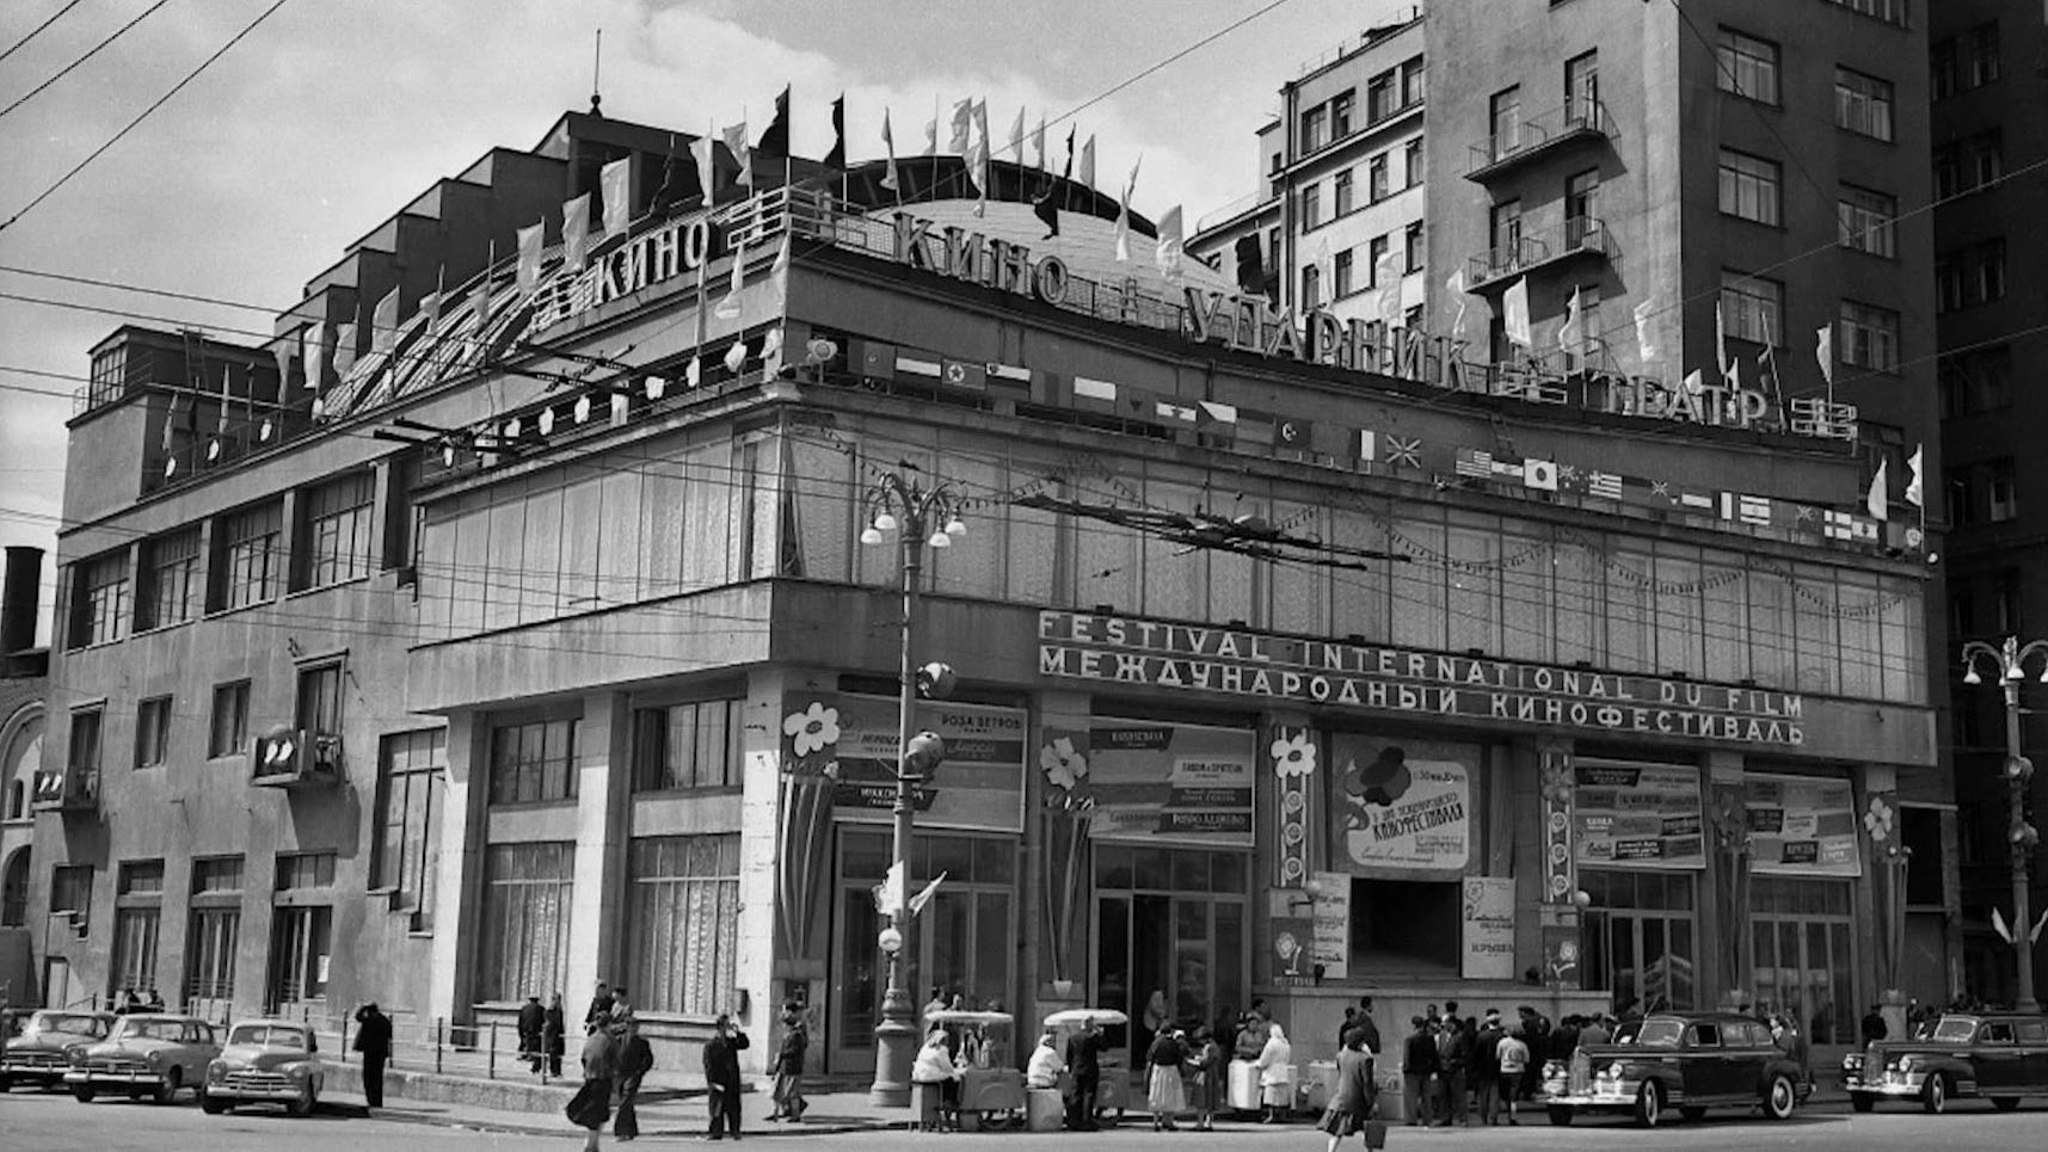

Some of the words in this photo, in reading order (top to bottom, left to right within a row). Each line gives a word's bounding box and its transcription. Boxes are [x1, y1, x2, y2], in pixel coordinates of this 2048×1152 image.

[593, 216, 709, 306] КИНО
[893, 212, 1068, 304] КИНО
[1184, 287, 1470, 392] УДАРНИК
[1039, 610, 1270, 662] FESTIVAL
[1304, 641, 1632, 699] INTERNATIONAL
[1661, 681, 1699, 706] DU
[1728, 689, 1801, 717] FILM
[1039, 645, 1457, 714] МЕЖДУНАРОДНЫЙ
[1492, 693, 1804, 745] КИНОФЕСТИВАЛЬ
[942, 716, 974, 727] РОЗА
